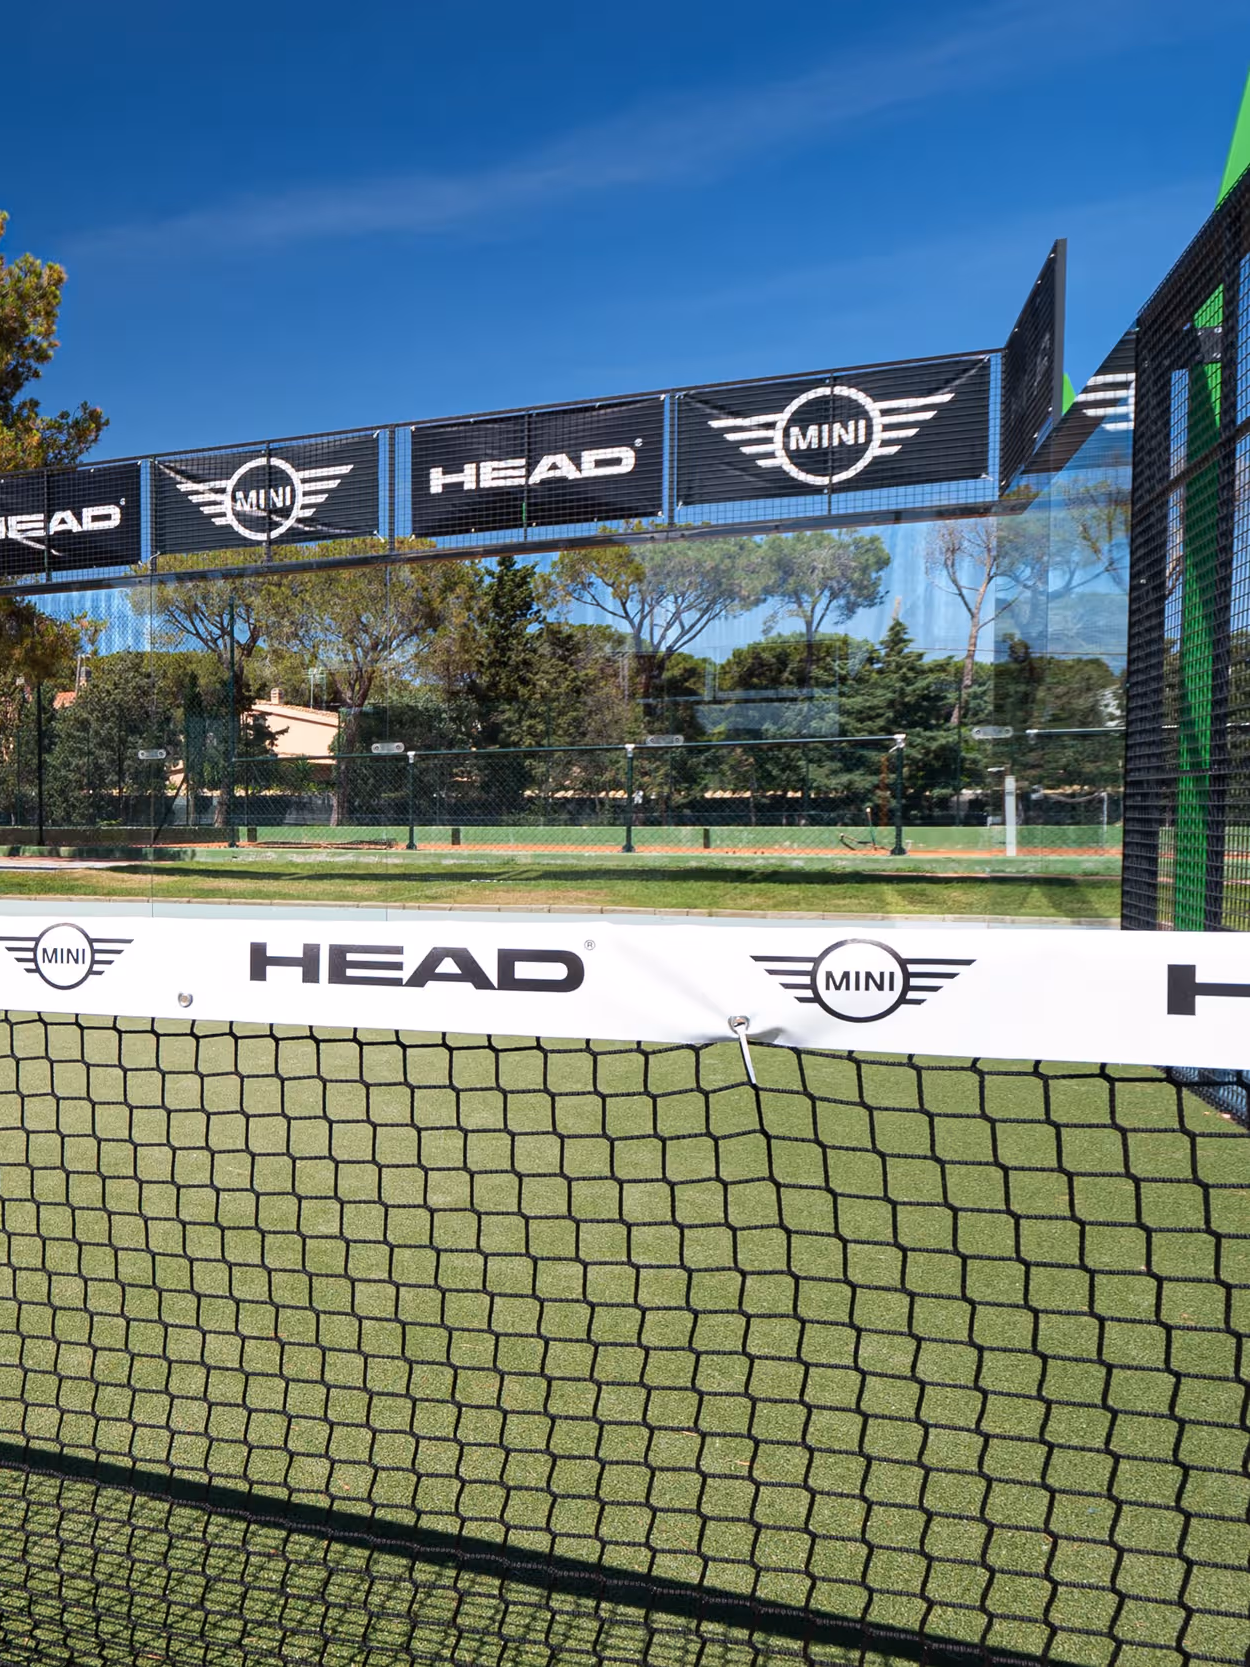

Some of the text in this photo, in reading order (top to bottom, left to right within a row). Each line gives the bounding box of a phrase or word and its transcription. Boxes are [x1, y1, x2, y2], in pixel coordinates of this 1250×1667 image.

[790, 419, 867, 450] MINI
[430, 446, 636, 494] HEAD
[236, 486, 291, 511] MINI
[42, 947, 86, 965] MINI
[249, 942, 585, 993] HEAD
[825, 970, 895, 992] MINI
